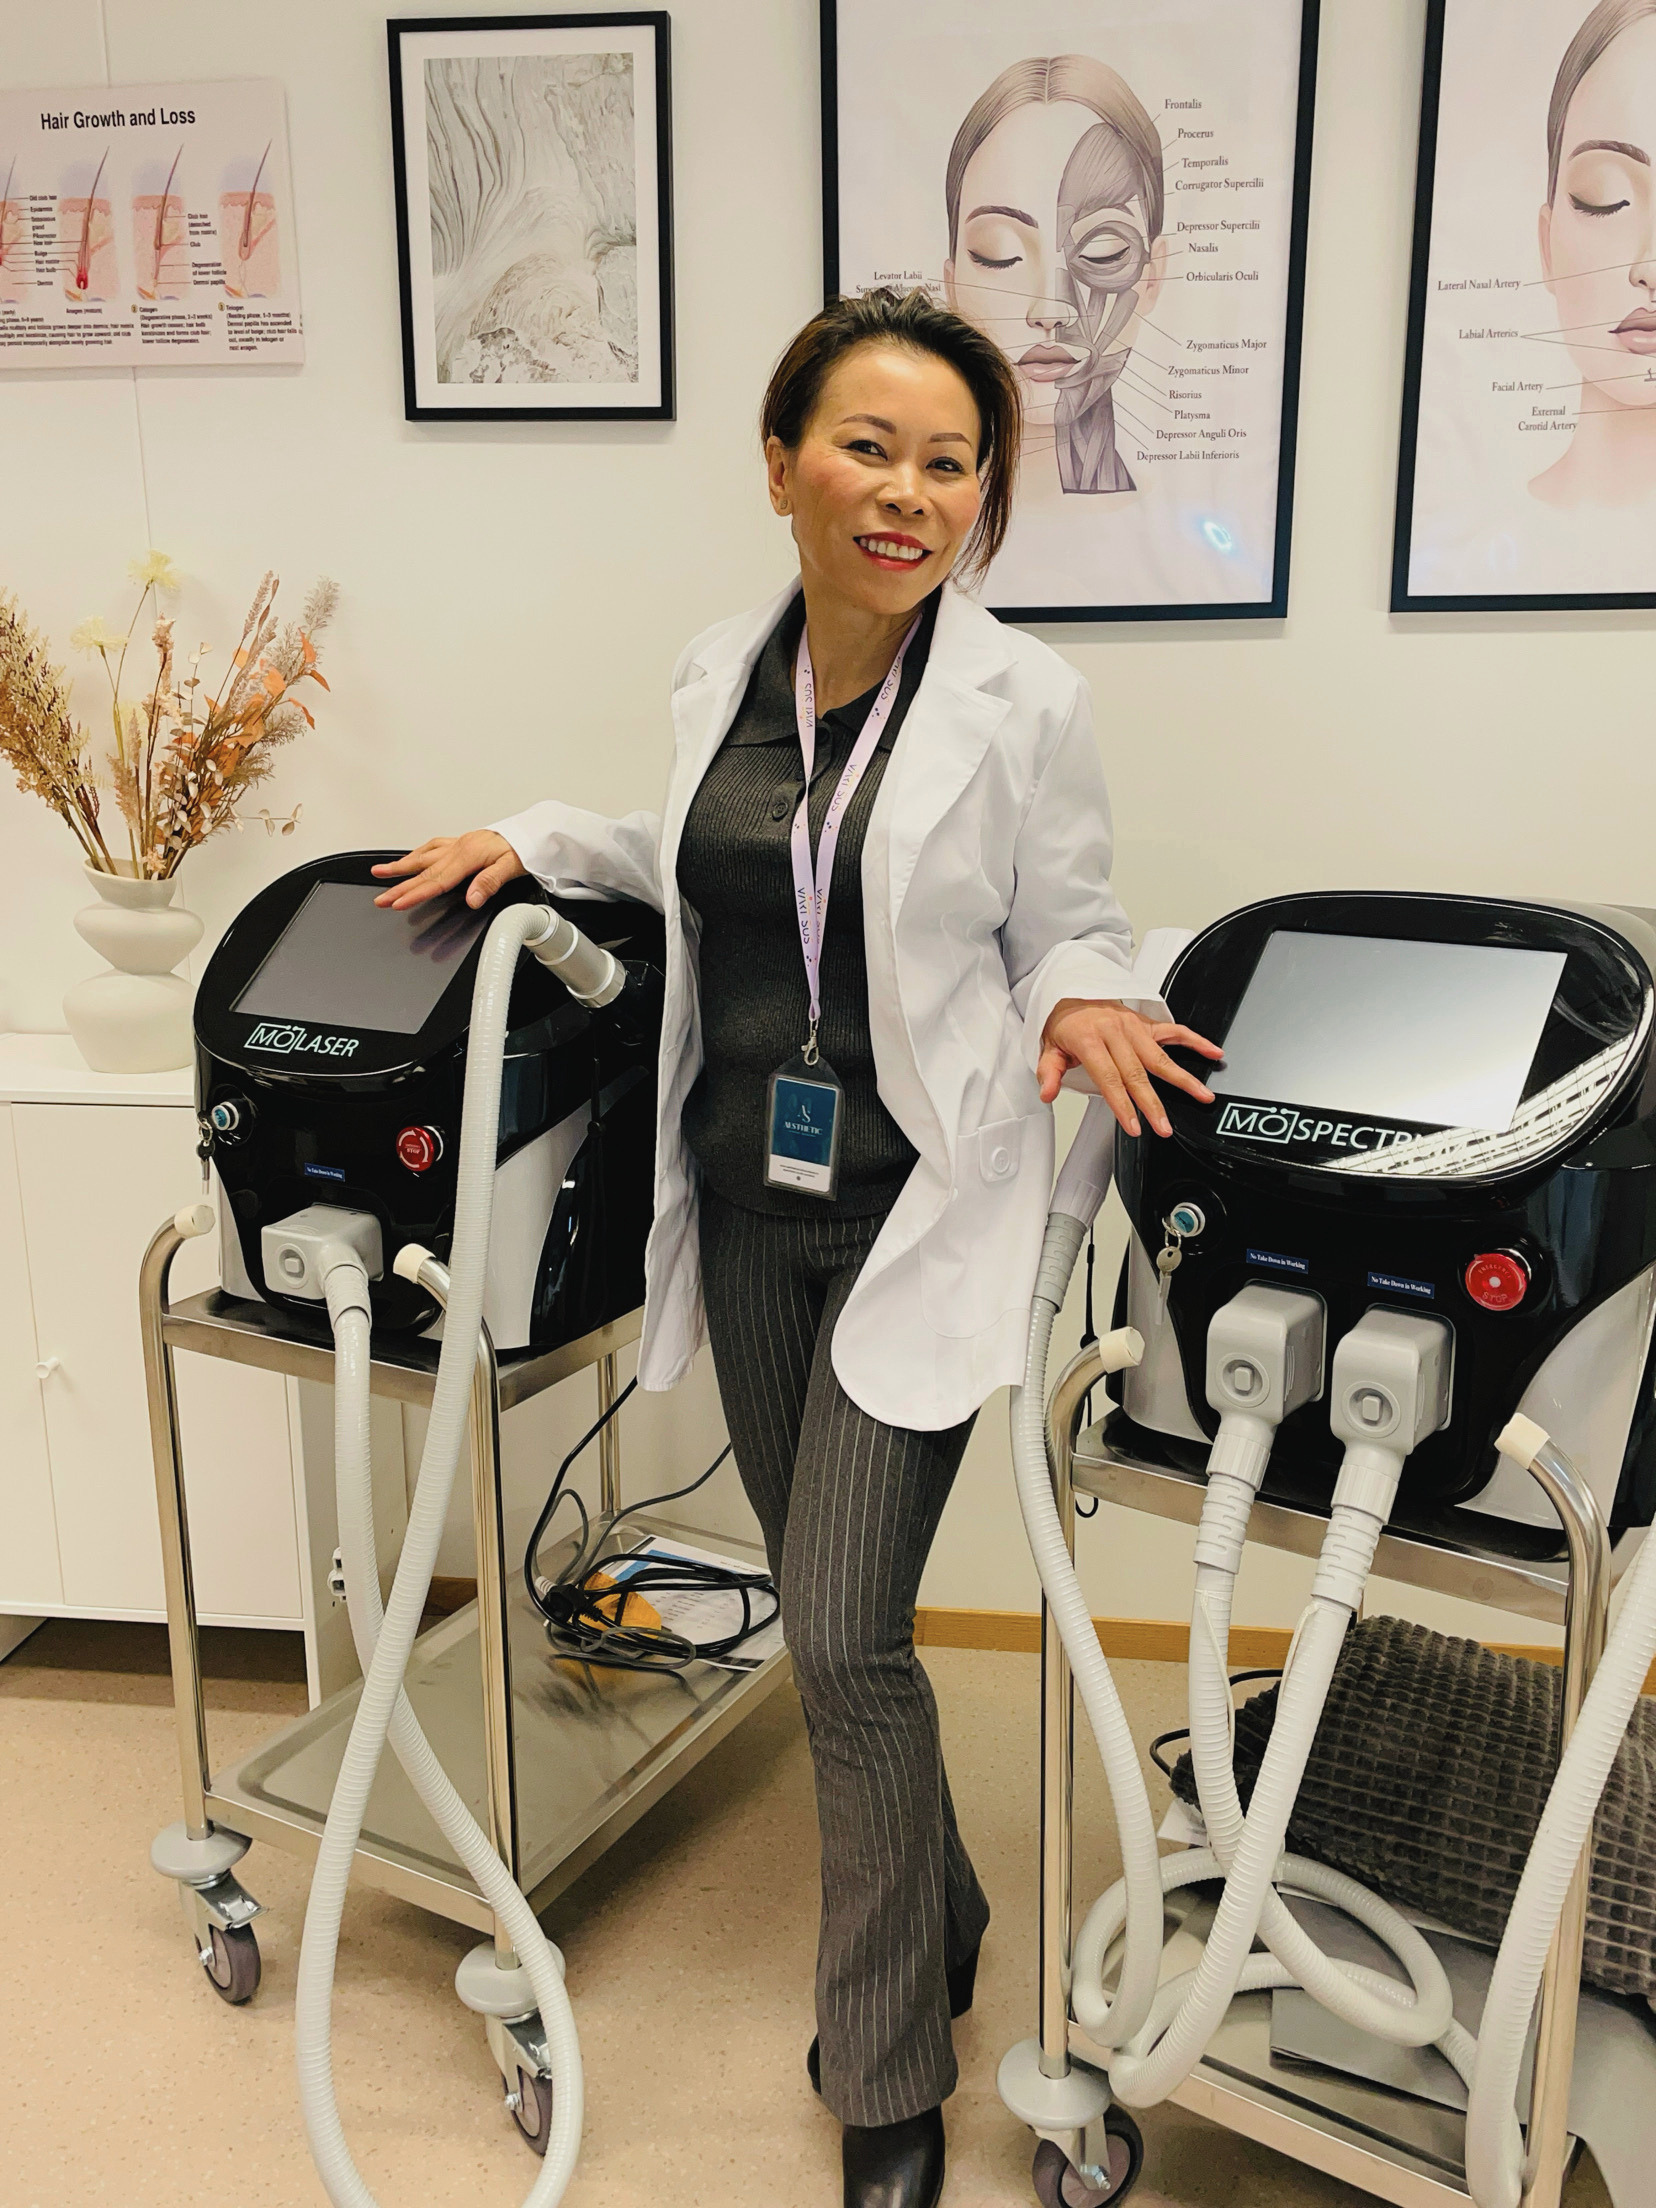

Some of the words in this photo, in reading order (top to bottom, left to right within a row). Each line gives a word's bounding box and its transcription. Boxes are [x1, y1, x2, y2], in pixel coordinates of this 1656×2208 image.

[1164, 99, 1202, 111] Frontalis
[41, 113, 68, 130] Hair
[74, 110, 125, 129] Growth
[130, 108, 156, 126] and
[161, 108, 196, 124] Loss
[1177, 128, 1213, 140] Procerus
[1182, 156, 1229, 169] Temporalis
[1175, 178, 1222, 192] Corrugator
[1224, 177, 1264, 189] Supercilii
[1177, 220, 1218, 233] Depressor
[1220, 220, 1260, 232] Supercilii
[1188, 242, 1218, 253] Nasalis
[874, 271, 901, 281] Levator
[904, 270, 922, 280] Labii
[1186, 271, 1233, 282] Orbicularis
[1236, 270, 1259, 281] Oculi
[1438, 280, 1466, 290] Lateral
[1469, 280, 1492, 289] Nasal
[1494, 278, 1521, 290] Artery
[1459, 329, 1484, 339] Labial
[1486, 329, 1518, 339] Arteries
[1186, 338, 1239, 351] Zygomaticus
[1241, 338, 1267, 350] Major
[1168, 365, 1220, 377] Zygomaticus
[1222, 364, 1249, 376] Minor
[1492, 382, 1515, 391] Facial
[1517, 381, 1543, 393] Artery
[1169, 389, 1202, 400] Risorius
[1174, 409, 1211, 422] Platysma
[1532, 406, 1566, 416] External
[1518, 421, 1548, 431] Carotid
[1550, 421, 1578, 432] Artery
[1156, 428, 1196, 440] Depressor
[1198, 428, 1226, 440] Anguli
[1227, 428, 1247, 438] Oris
[1137, 450, 1176, 462] Depressor
[1178, 450, 1199, 460] Labii
[1201, 449, 1239, 460] Inferioris
[1268, 1256, 1280, 1264] Down
[1287, 1260, 1305, 1270] Working
[1391, 1280, 1404, 1288] Down
[1410, 1284, 1431, 1294] Working
[1483, 1292, 1508, 1303] STOP
